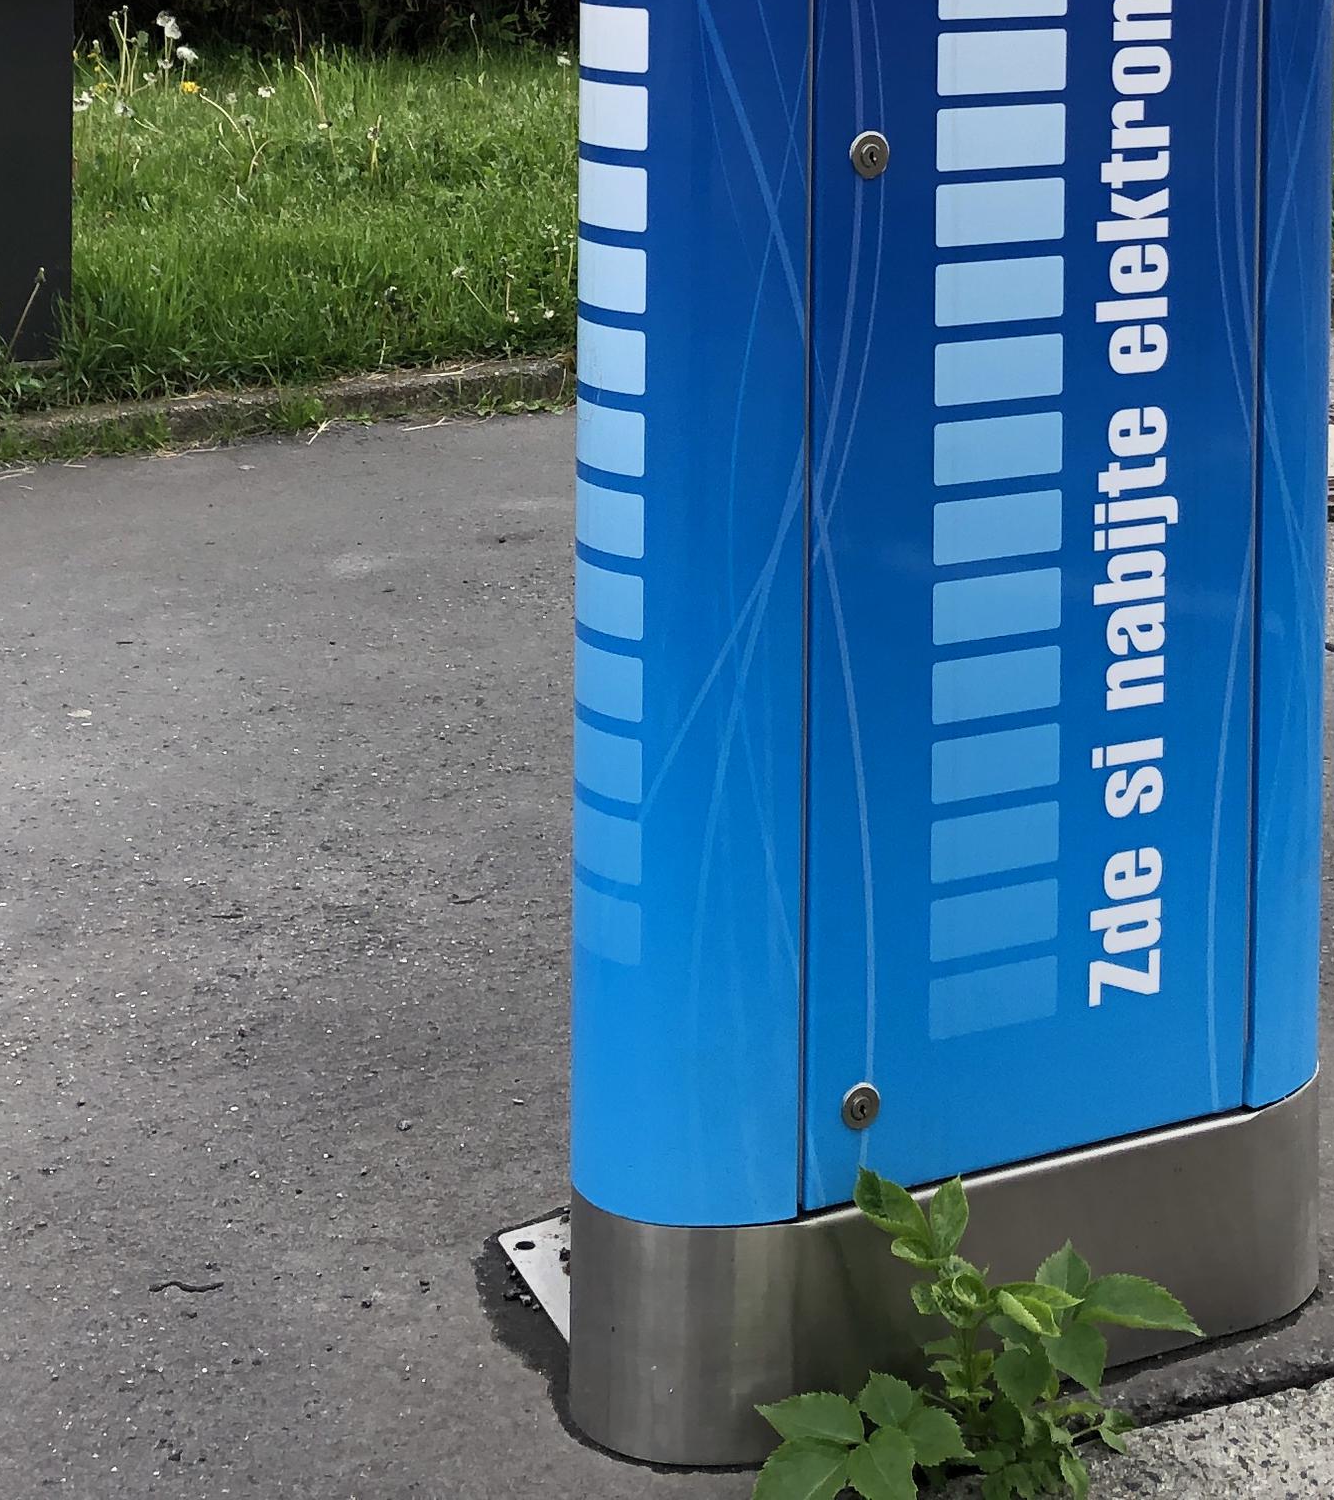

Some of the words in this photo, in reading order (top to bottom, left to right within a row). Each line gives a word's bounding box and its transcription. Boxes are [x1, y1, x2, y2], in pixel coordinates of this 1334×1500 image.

[1093, 405, 1179, 711] nabijte
[1091, 736, 1165, 819] si
[1088, 846, 1162, 1008] Zde
